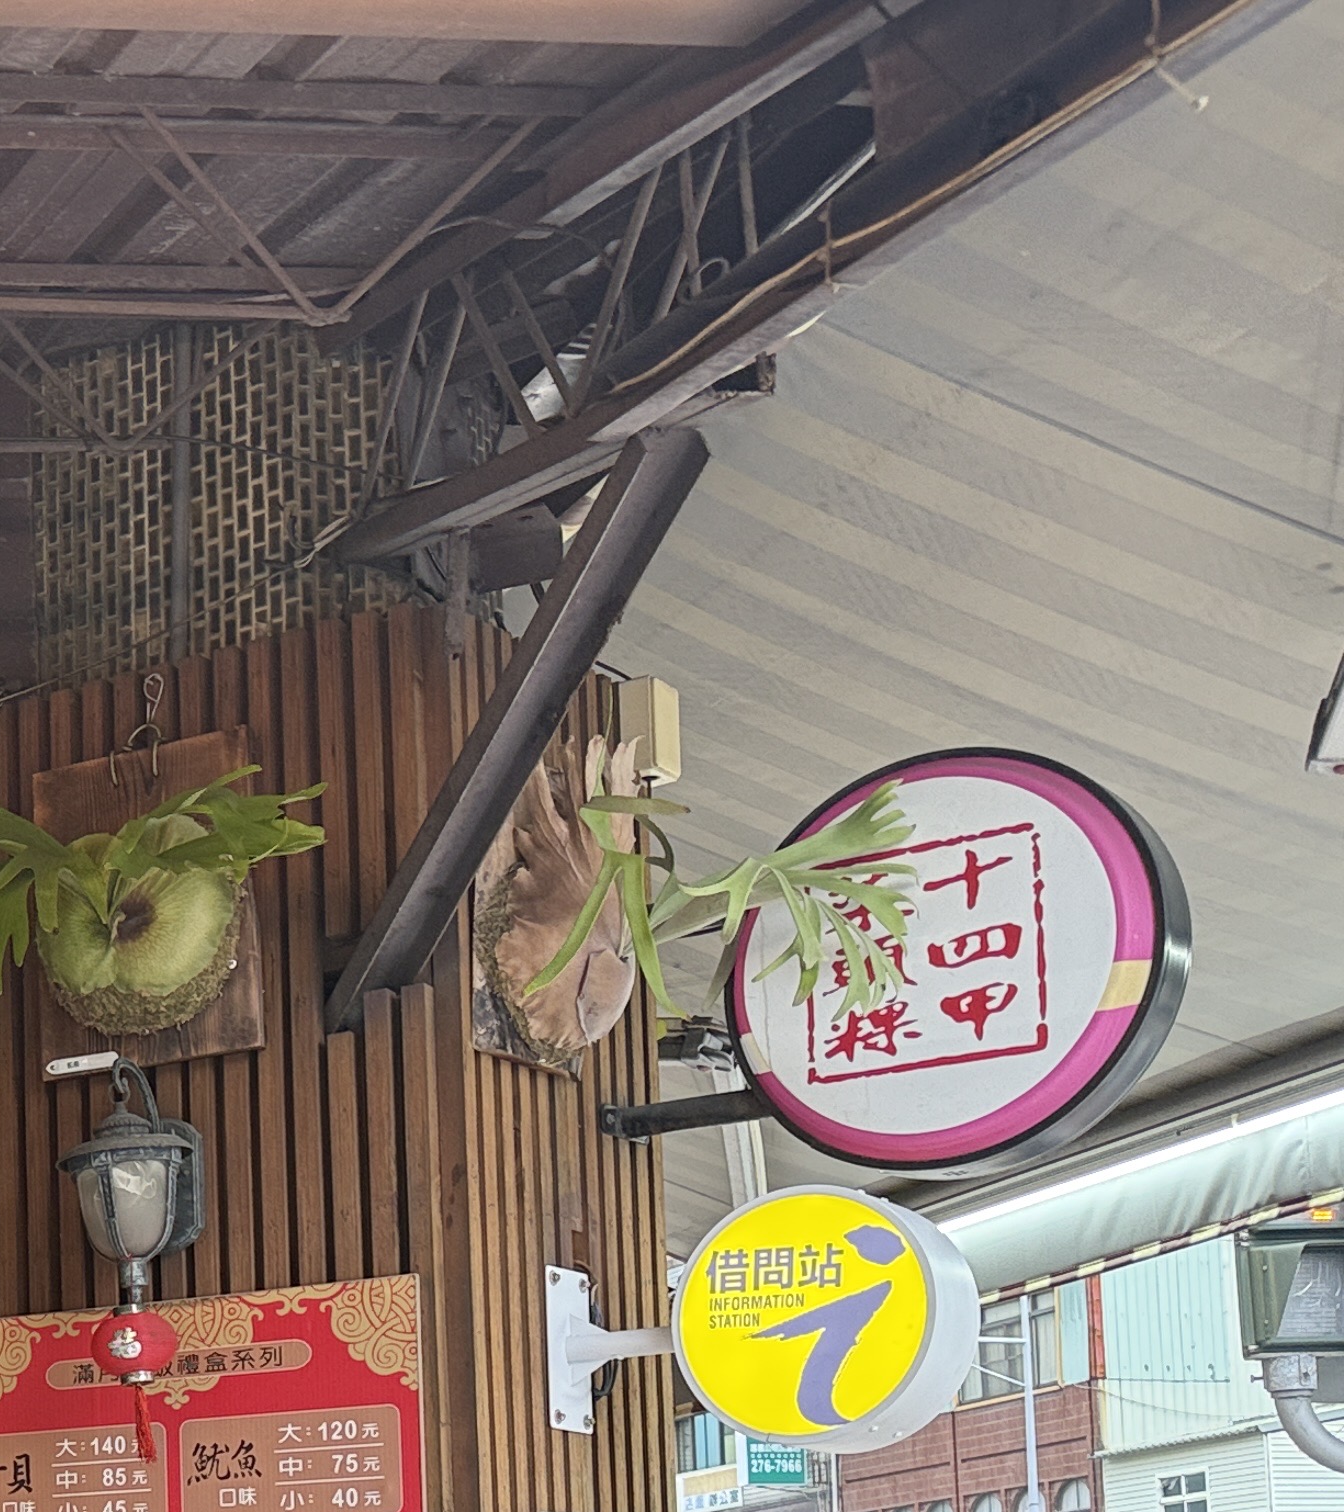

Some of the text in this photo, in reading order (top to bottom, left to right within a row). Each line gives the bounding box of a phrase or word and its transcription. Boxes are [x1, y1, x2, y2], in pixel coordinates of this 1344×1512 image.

[707, 1243, 844, 1294] 借問站
[710, 1293, 804, 1312] INFORMATION
[709, 1313, 760, 1329] STATION
[188, 1439, 262, 1486] 魷魚
[751, 1460, 802, 1473] 276-7966
[219, 1488, 257, 1507] 口味
